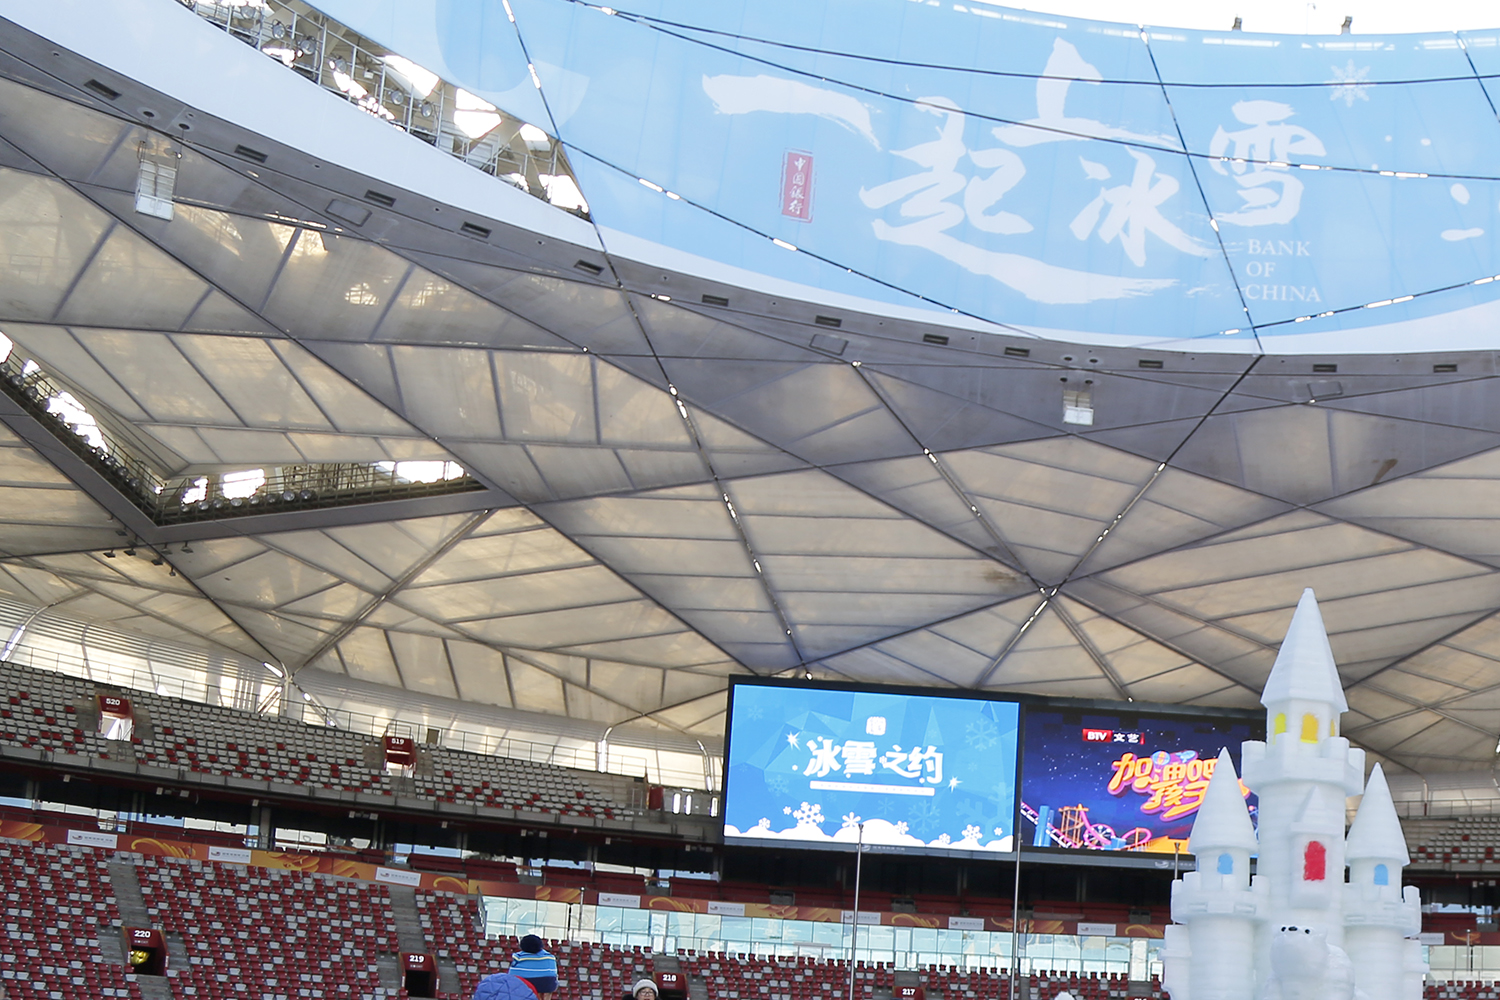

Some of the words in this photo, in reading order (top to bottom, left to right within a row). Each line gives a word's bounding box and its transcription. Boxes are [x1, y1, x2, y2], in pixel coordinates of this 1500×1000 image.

[1247, 238, 1312, 257] BANK
[1245, 260, 1277, 278] OF
[1244, 283, 1322, 303] CHINA
[105, 697, 121, 706] 520
[1087, 731, 1108, 741] BTV
[1113, 732, 1140, 744] 文艺
[803, 738, 944, 785] 冰雪之约
[133, 929, 151, 939] 220
[409, 954, 425, 964] 219
[902, 988, 916, 996] 217
